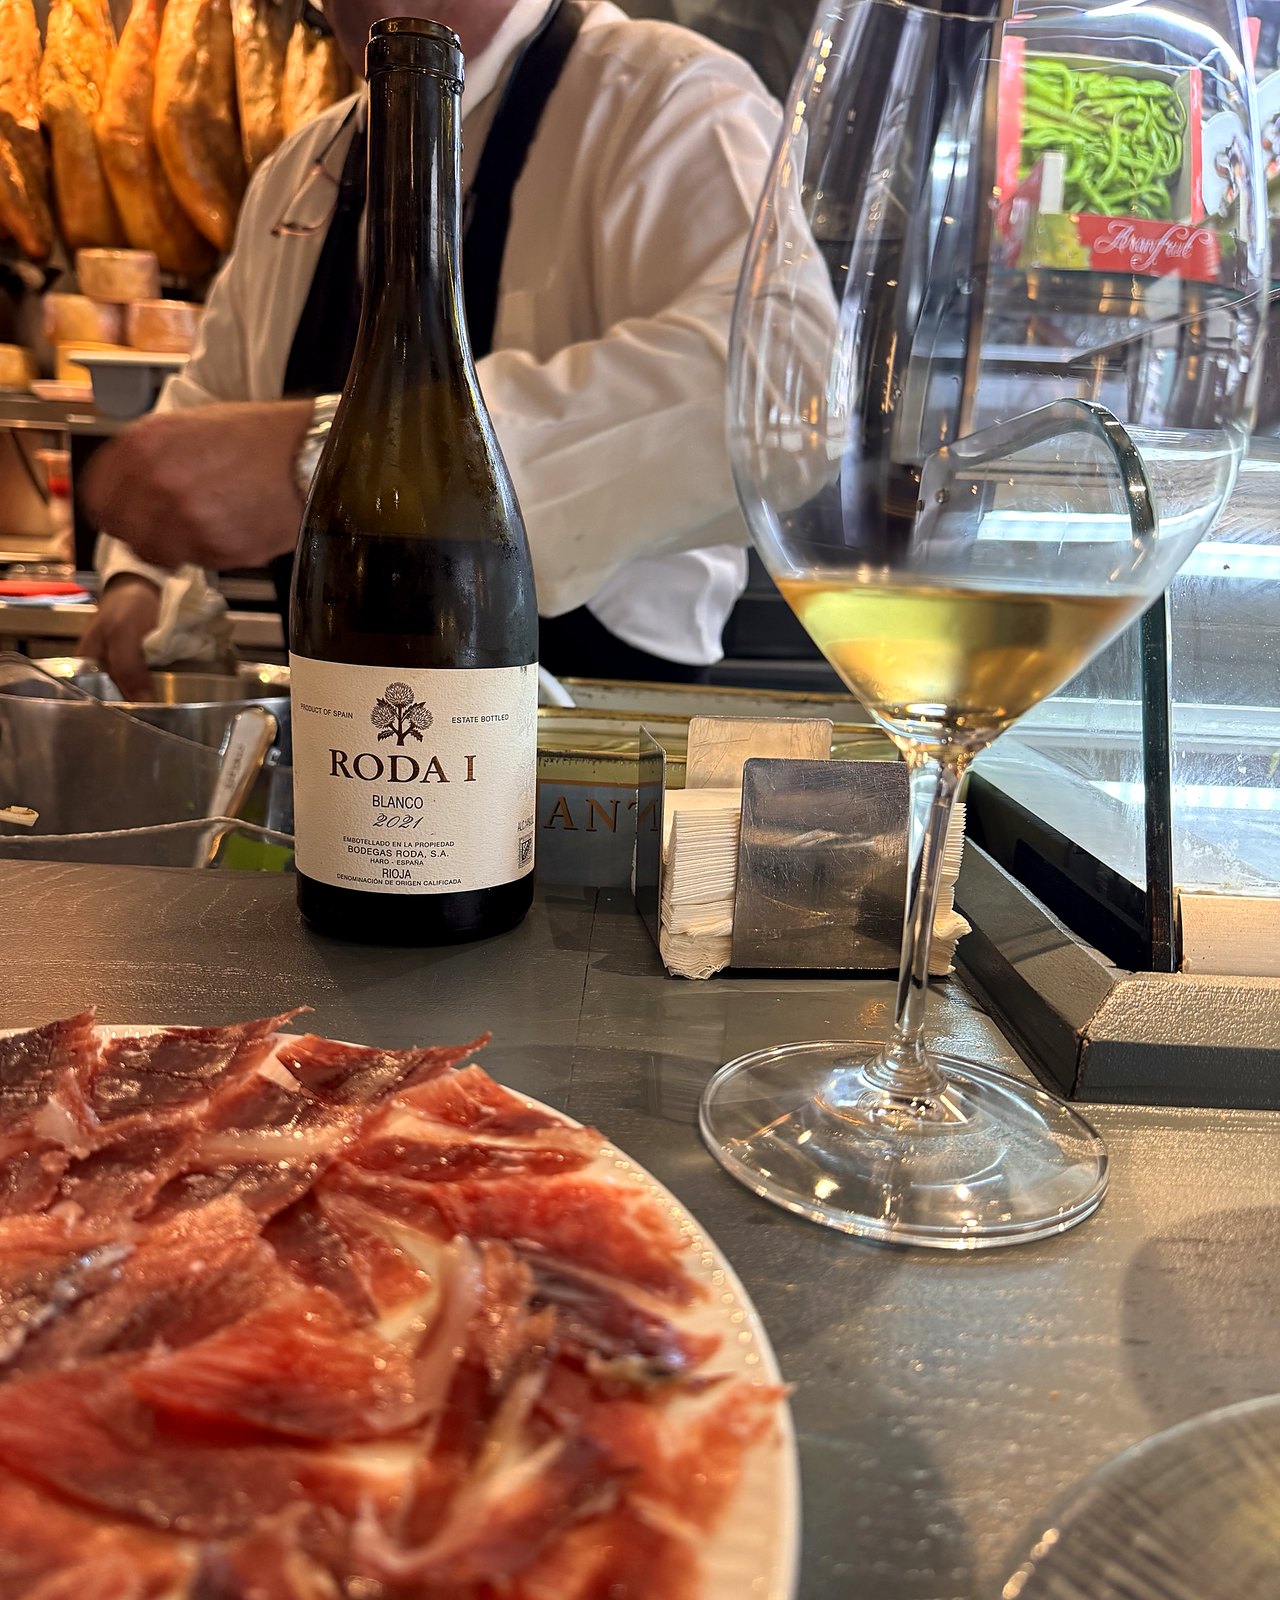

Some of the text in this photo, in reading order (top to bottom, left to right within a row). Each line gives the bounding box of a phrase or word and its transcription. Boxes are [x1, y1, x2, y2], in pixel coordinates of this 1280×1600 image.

[300, 702, 354, 720] PRODUCT OF SPAIN
[451, 713, 510, 725] ESTATE BOTTLED
[328, 748, 477, 784] RODA I
[372, 794, 424, 810] BLANCO
[372, 812, 424, 830] 2021
[543, 795, 637, 833] AN
[343, 835, 391, 847] EMBOTELLADO
[414, 840, 455, 848] PROPIEDAD
[347, 845, 449, 859] BODEGAS RODA, S.A.
[396, 858, 424, 866] ESPAÑA
[336, 872, 383, 885] DENOMINACIÓN
[396, 879, 422, 887] ORIGEN
[423, 877, 462, 887] CALIFICADA
[382, 868, 412, 880] RIOJA
